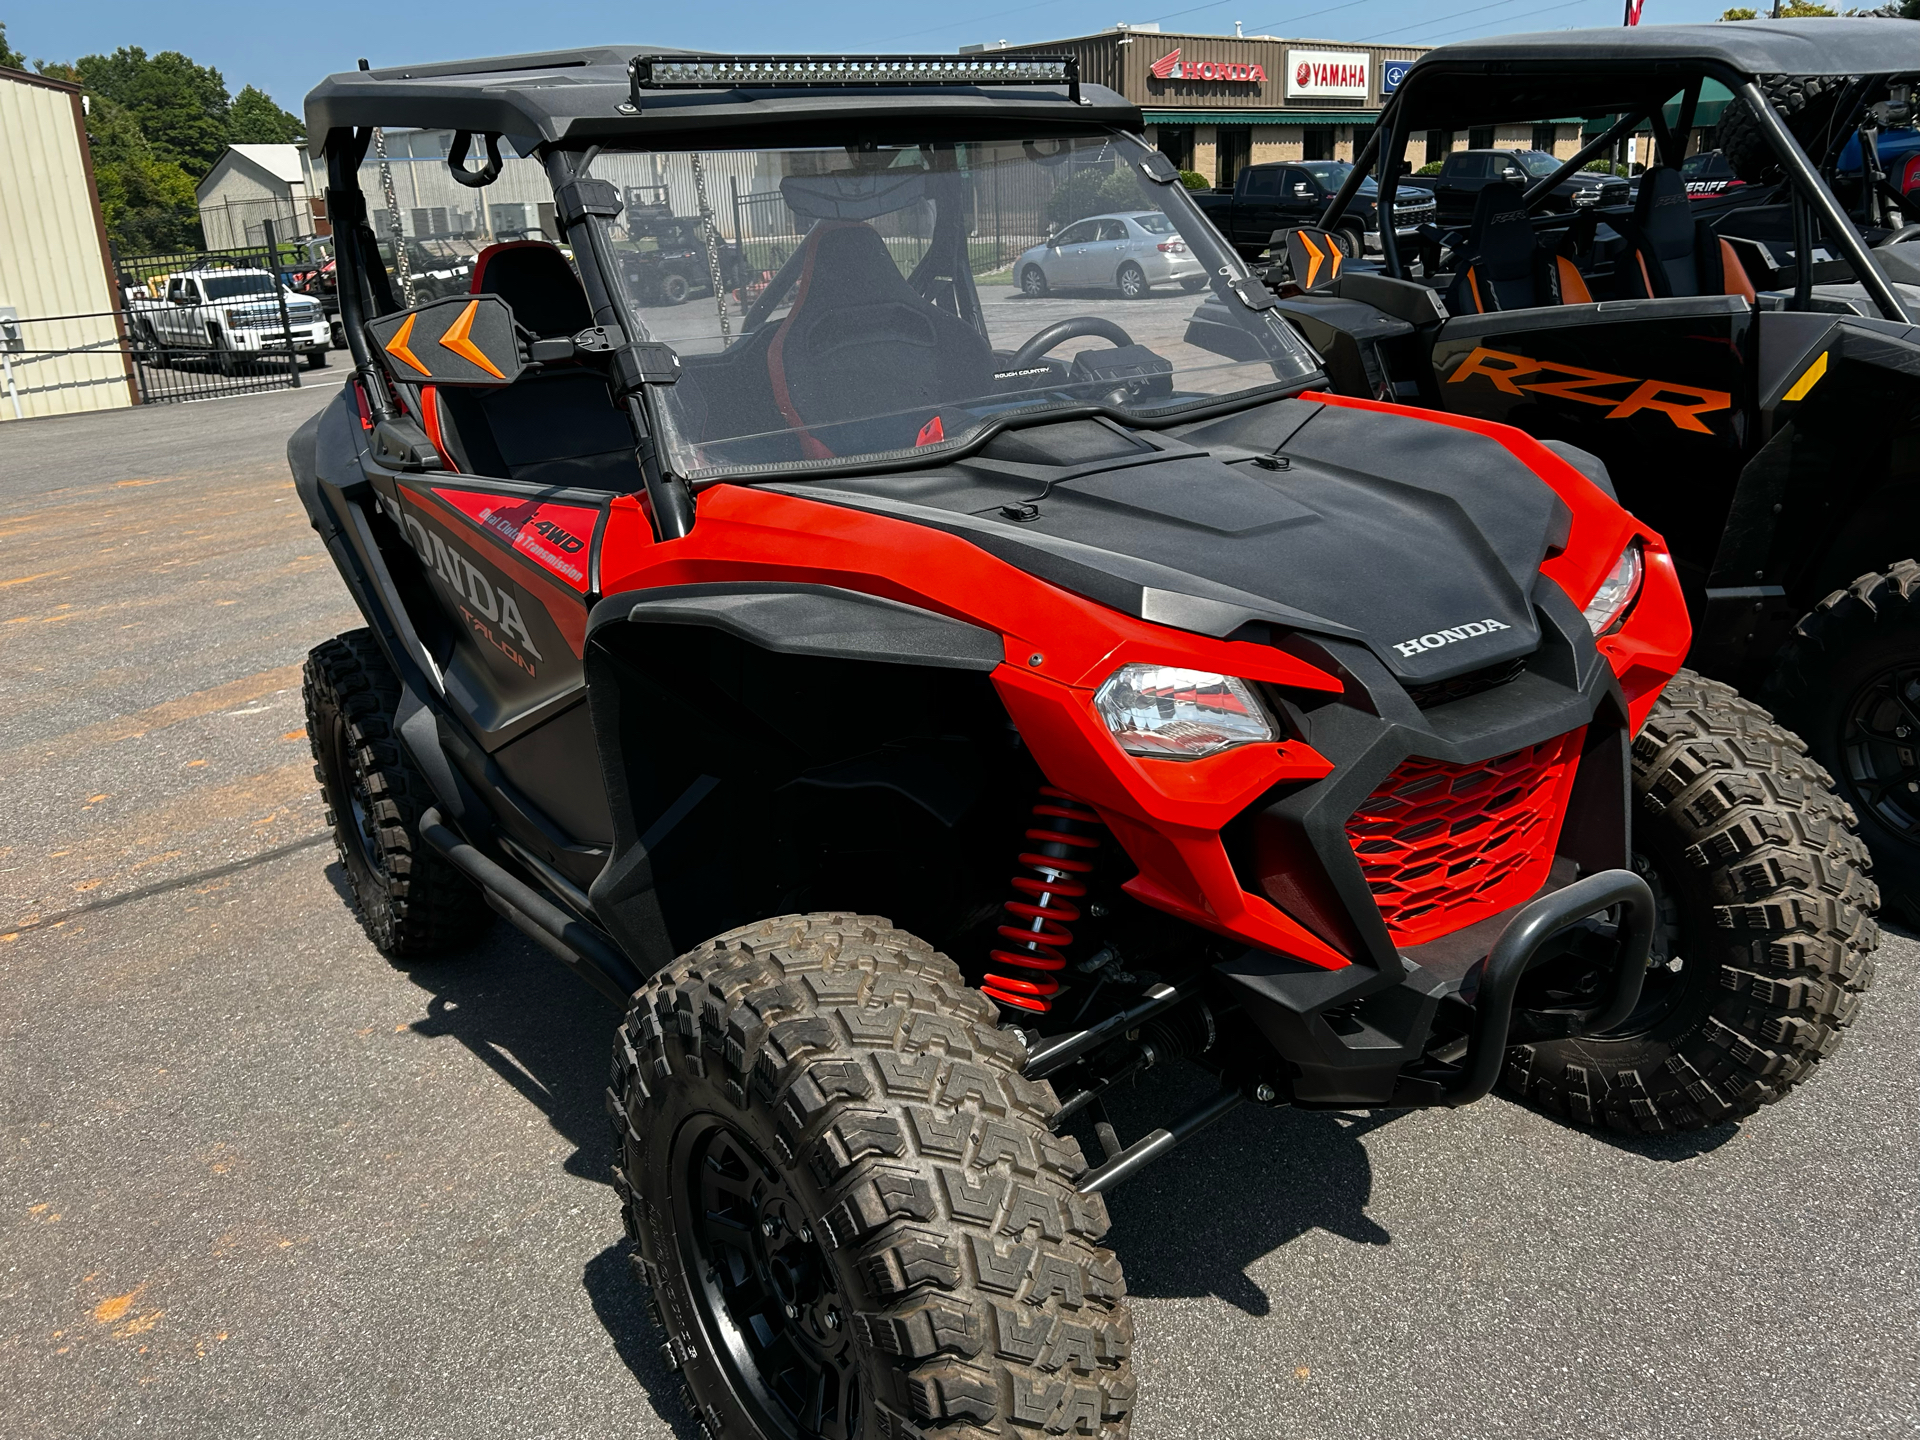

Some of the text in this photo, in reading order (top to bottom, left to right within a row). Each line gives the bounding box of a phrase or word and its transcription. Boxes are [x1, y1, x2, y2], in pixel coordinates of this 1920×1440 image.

[1181, 61, 1268, 82] HONDA
[1313, 63, 1366, 87] YAMAHA
[1685, 181, 1728, 192] ERIFF
[994, 367, 1050, 379] ROUGH COUNTRY
[1446, 346, 1731, 435] RZR
[478, 507, 584, 583] Dual Clutch Transmission
[459, 604, 537, 679] TALON
[1392, 618, 1511, 658] HONDA
